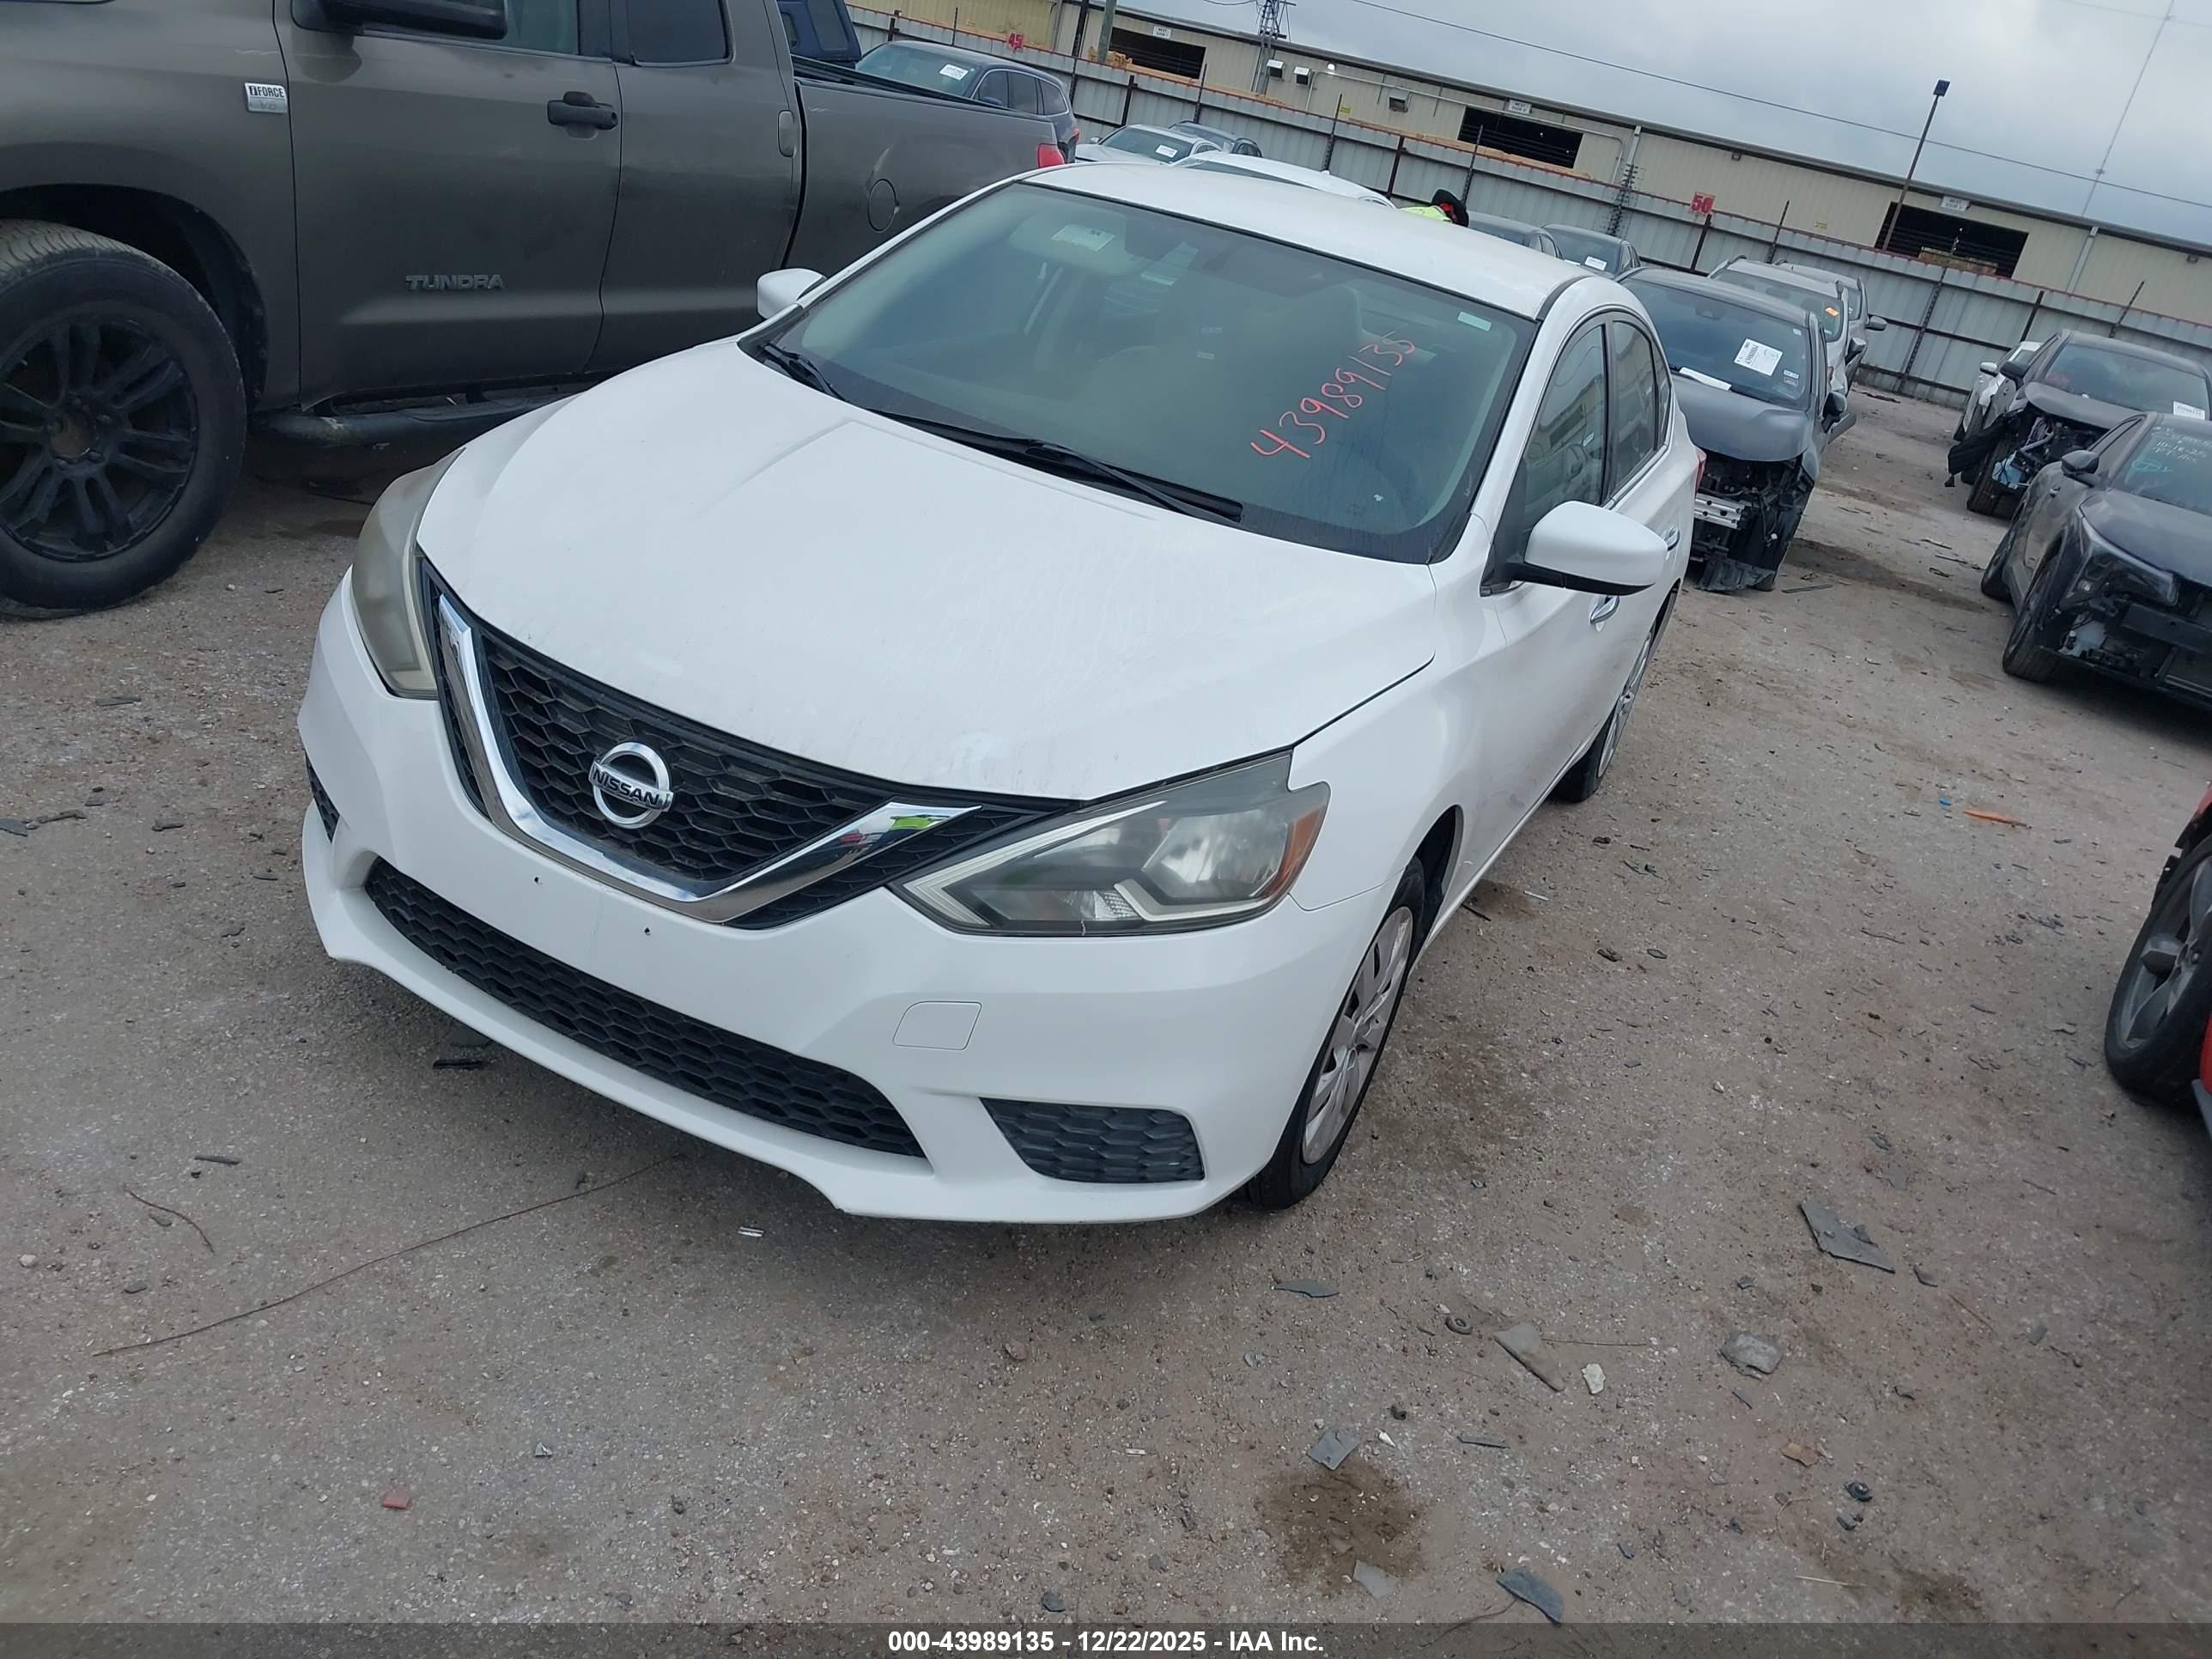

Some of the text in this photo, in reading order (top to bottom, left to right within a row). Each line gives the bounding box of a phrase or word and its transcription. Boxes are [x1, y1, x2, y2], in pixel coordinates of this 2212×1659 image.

[1692, 193, 1713, 214] 50
[404, 274, 505, 290] TUNDRA
[1250, 330, 1416, 459] 43989135
[592, 769, 660, 805] NISSAN
